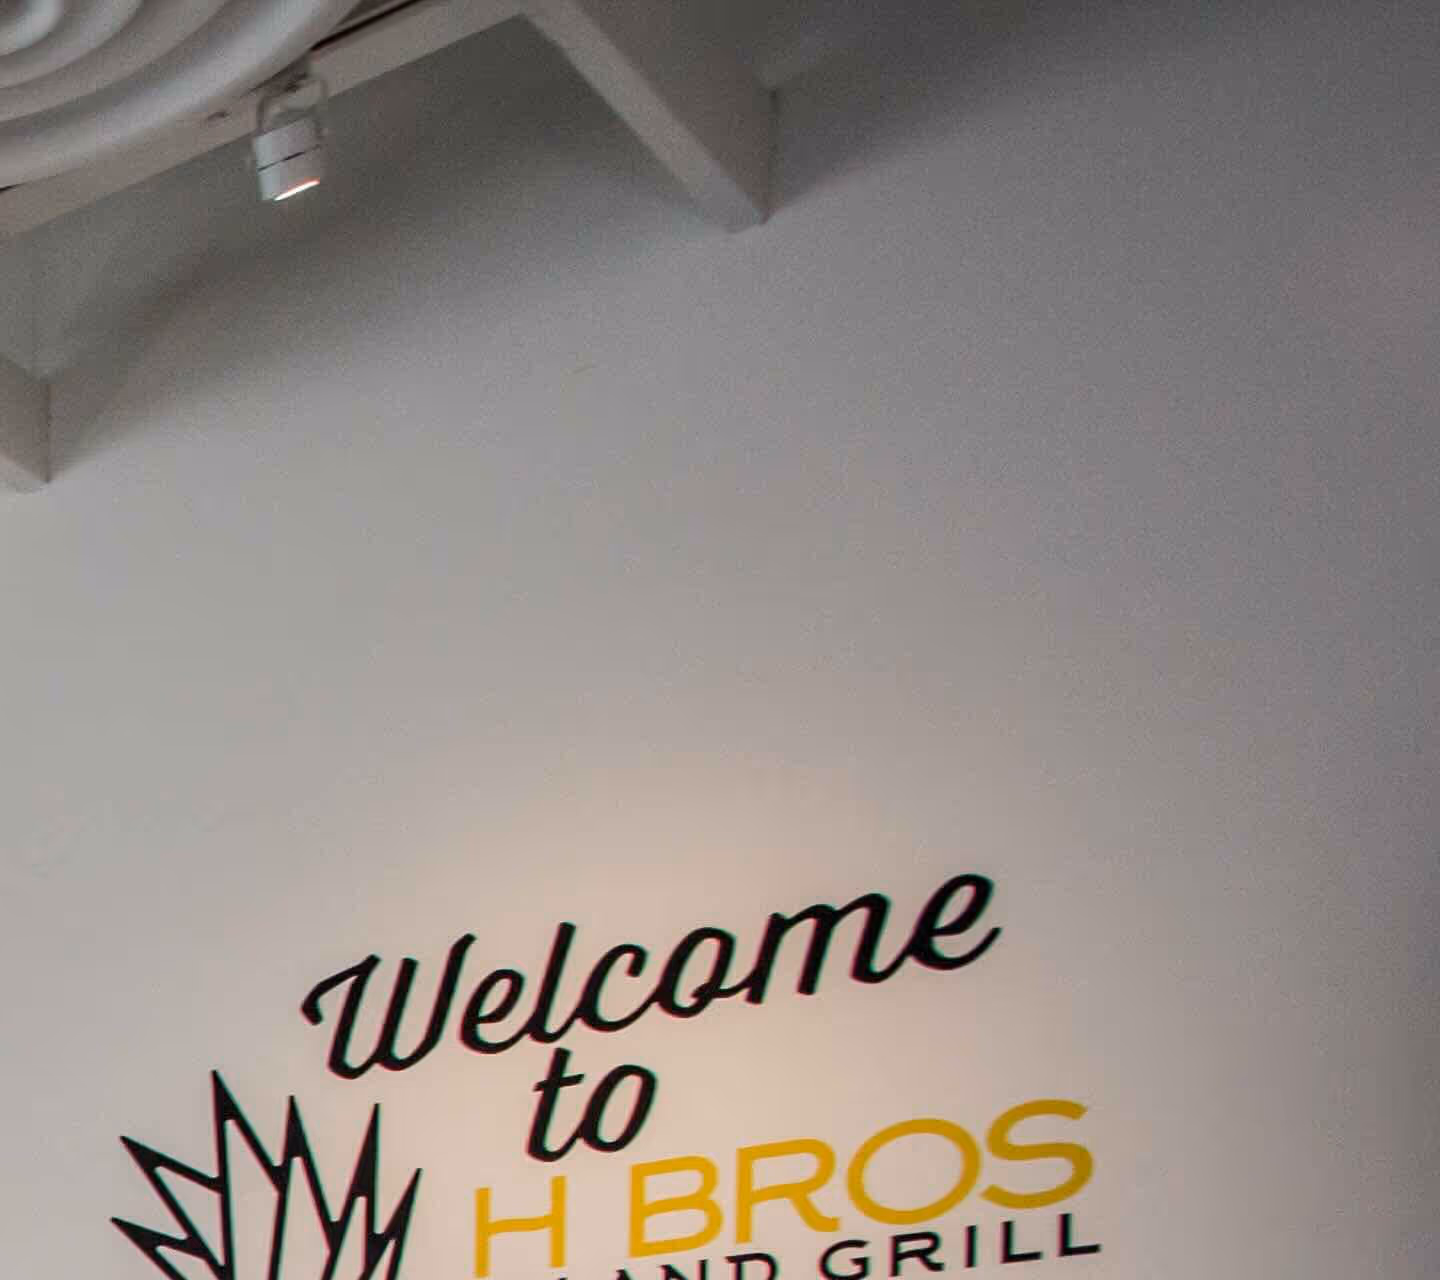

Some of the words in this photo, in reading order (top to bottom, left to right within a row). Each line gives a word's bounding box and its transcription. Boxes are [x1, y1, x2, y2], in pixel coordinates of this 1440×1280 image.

[301, 874, 1000, 1079] Welcome
[475, 1175, 565, 1278] H
[630, 1098, 1094, 1257] BROS
[526, 1048, 656, 1161] to
